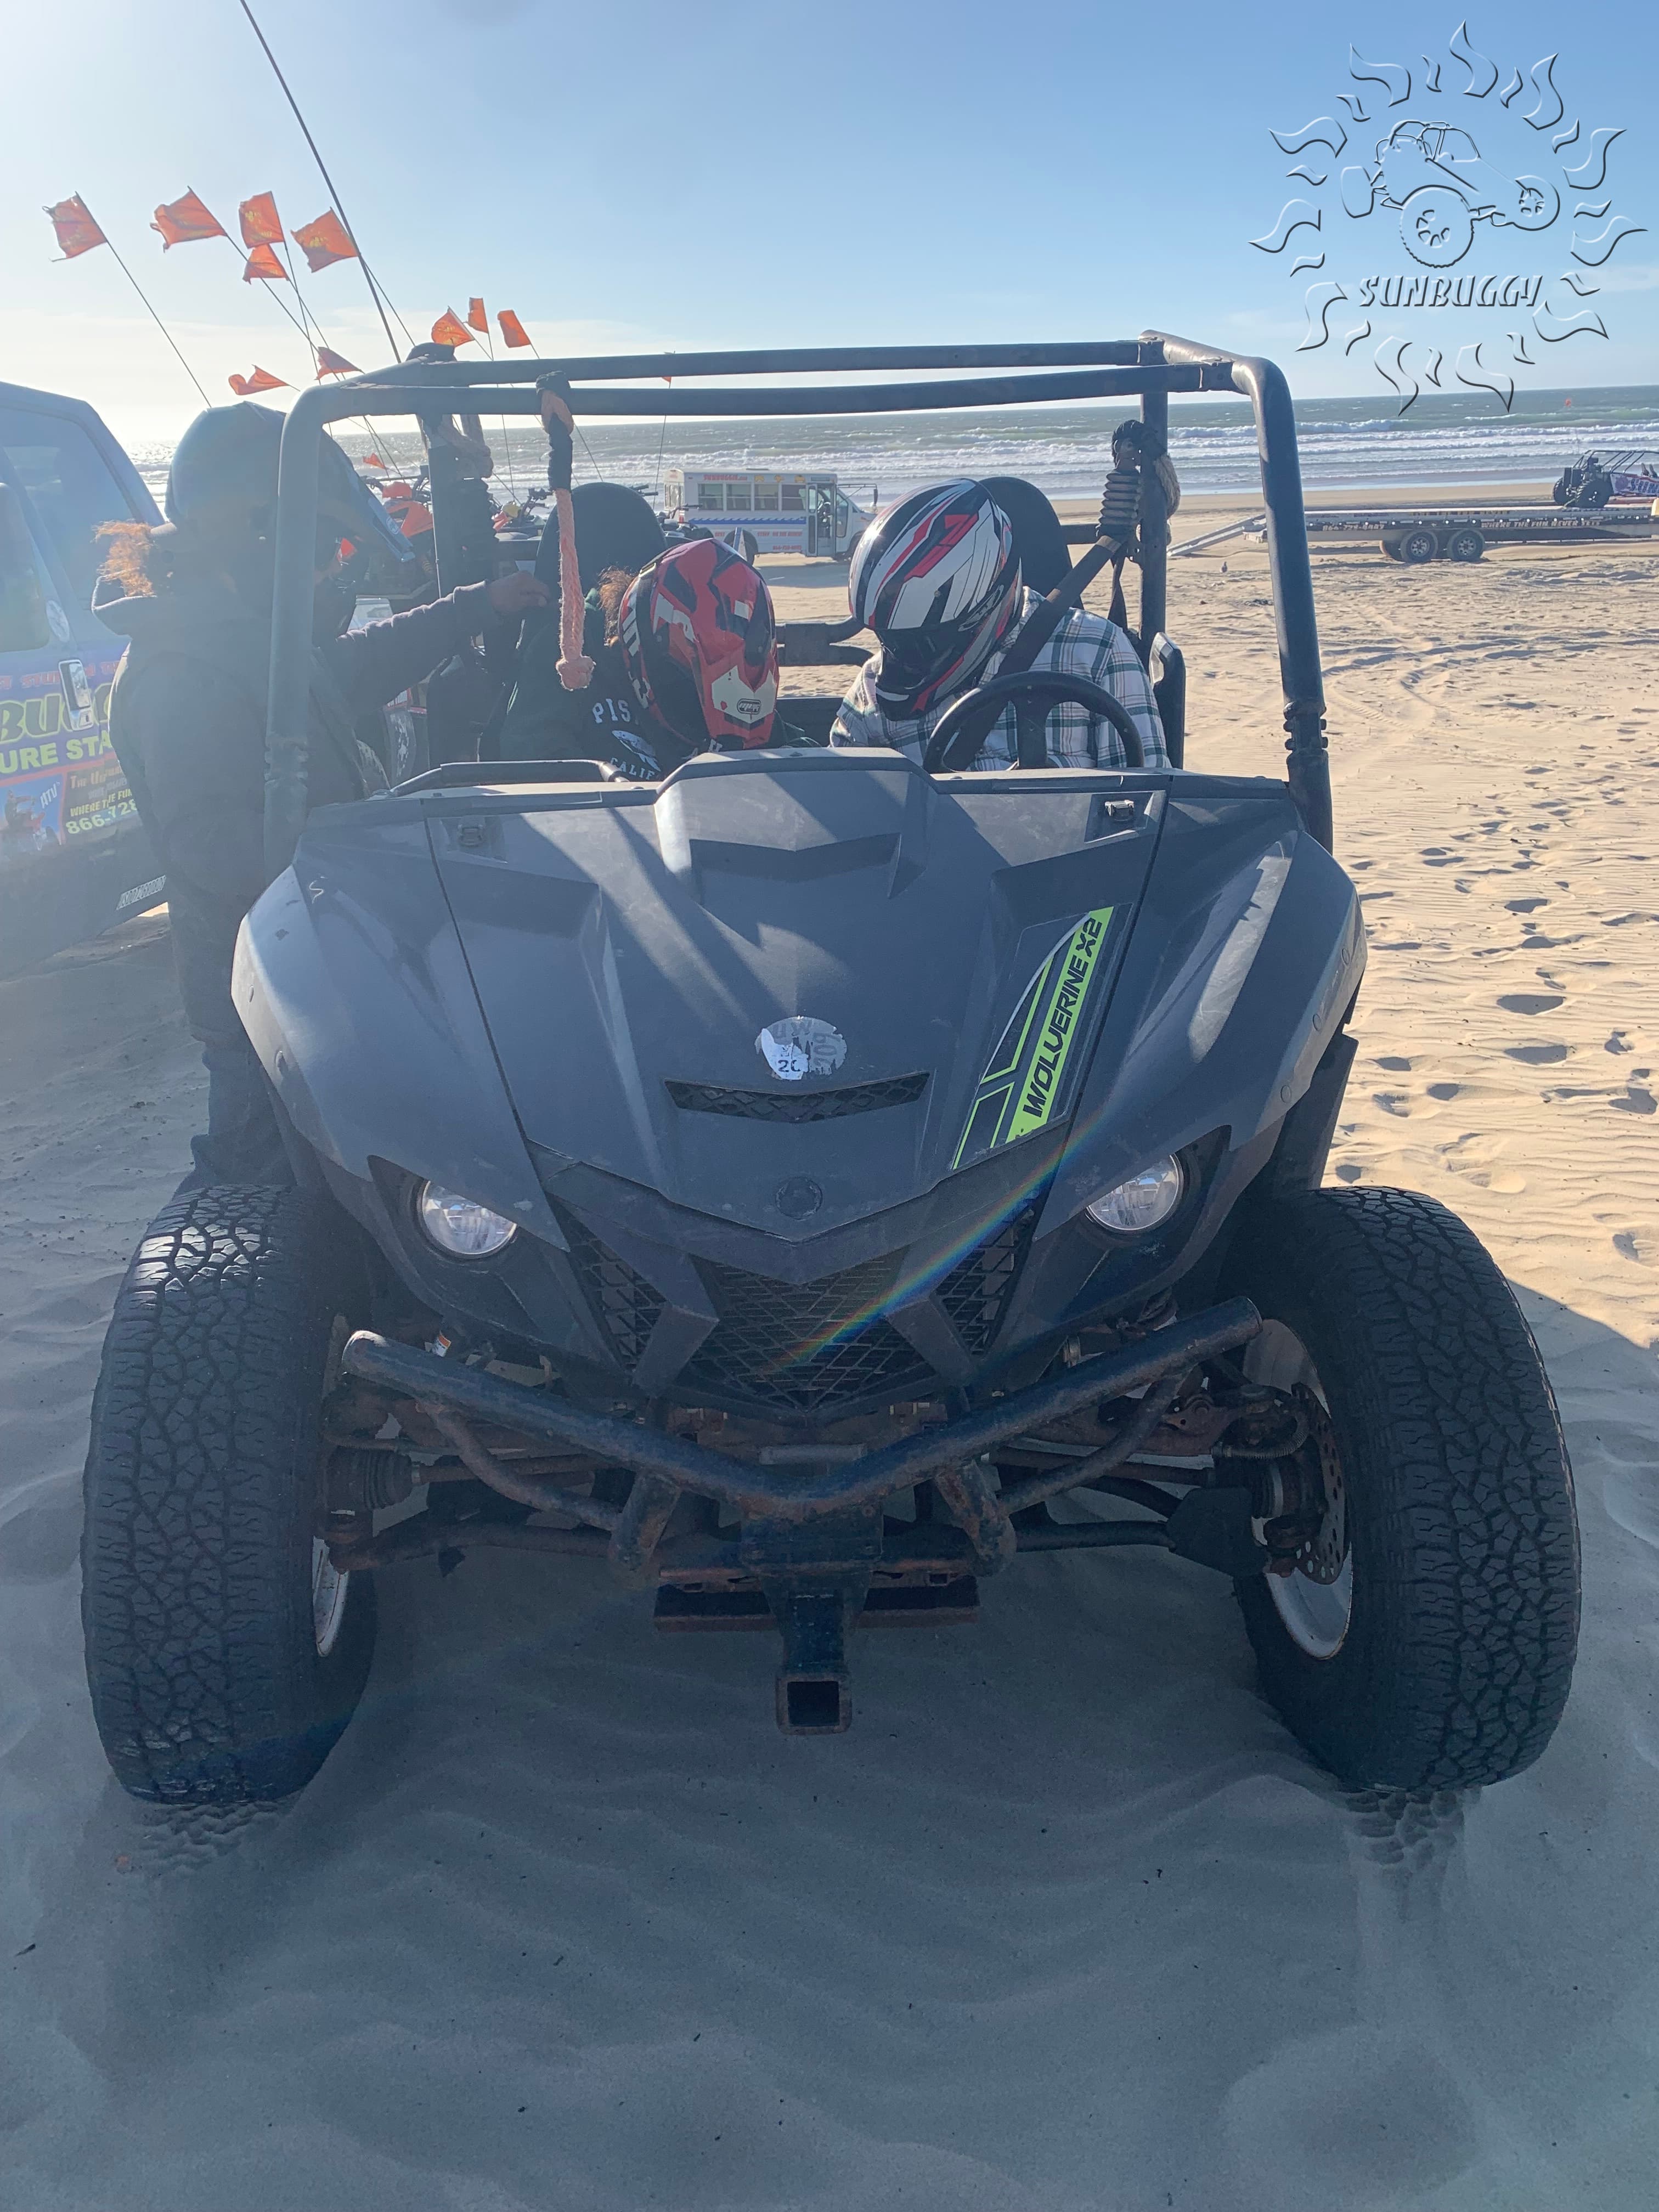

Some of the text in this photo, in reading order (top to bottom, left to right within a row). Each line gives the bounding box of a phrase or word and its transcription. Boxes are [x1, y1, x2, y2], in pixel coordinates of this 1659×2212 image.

[70, 800, 100, 816] WHERE
[1023, 917, 1102, 1118] WOLVERINE X2
